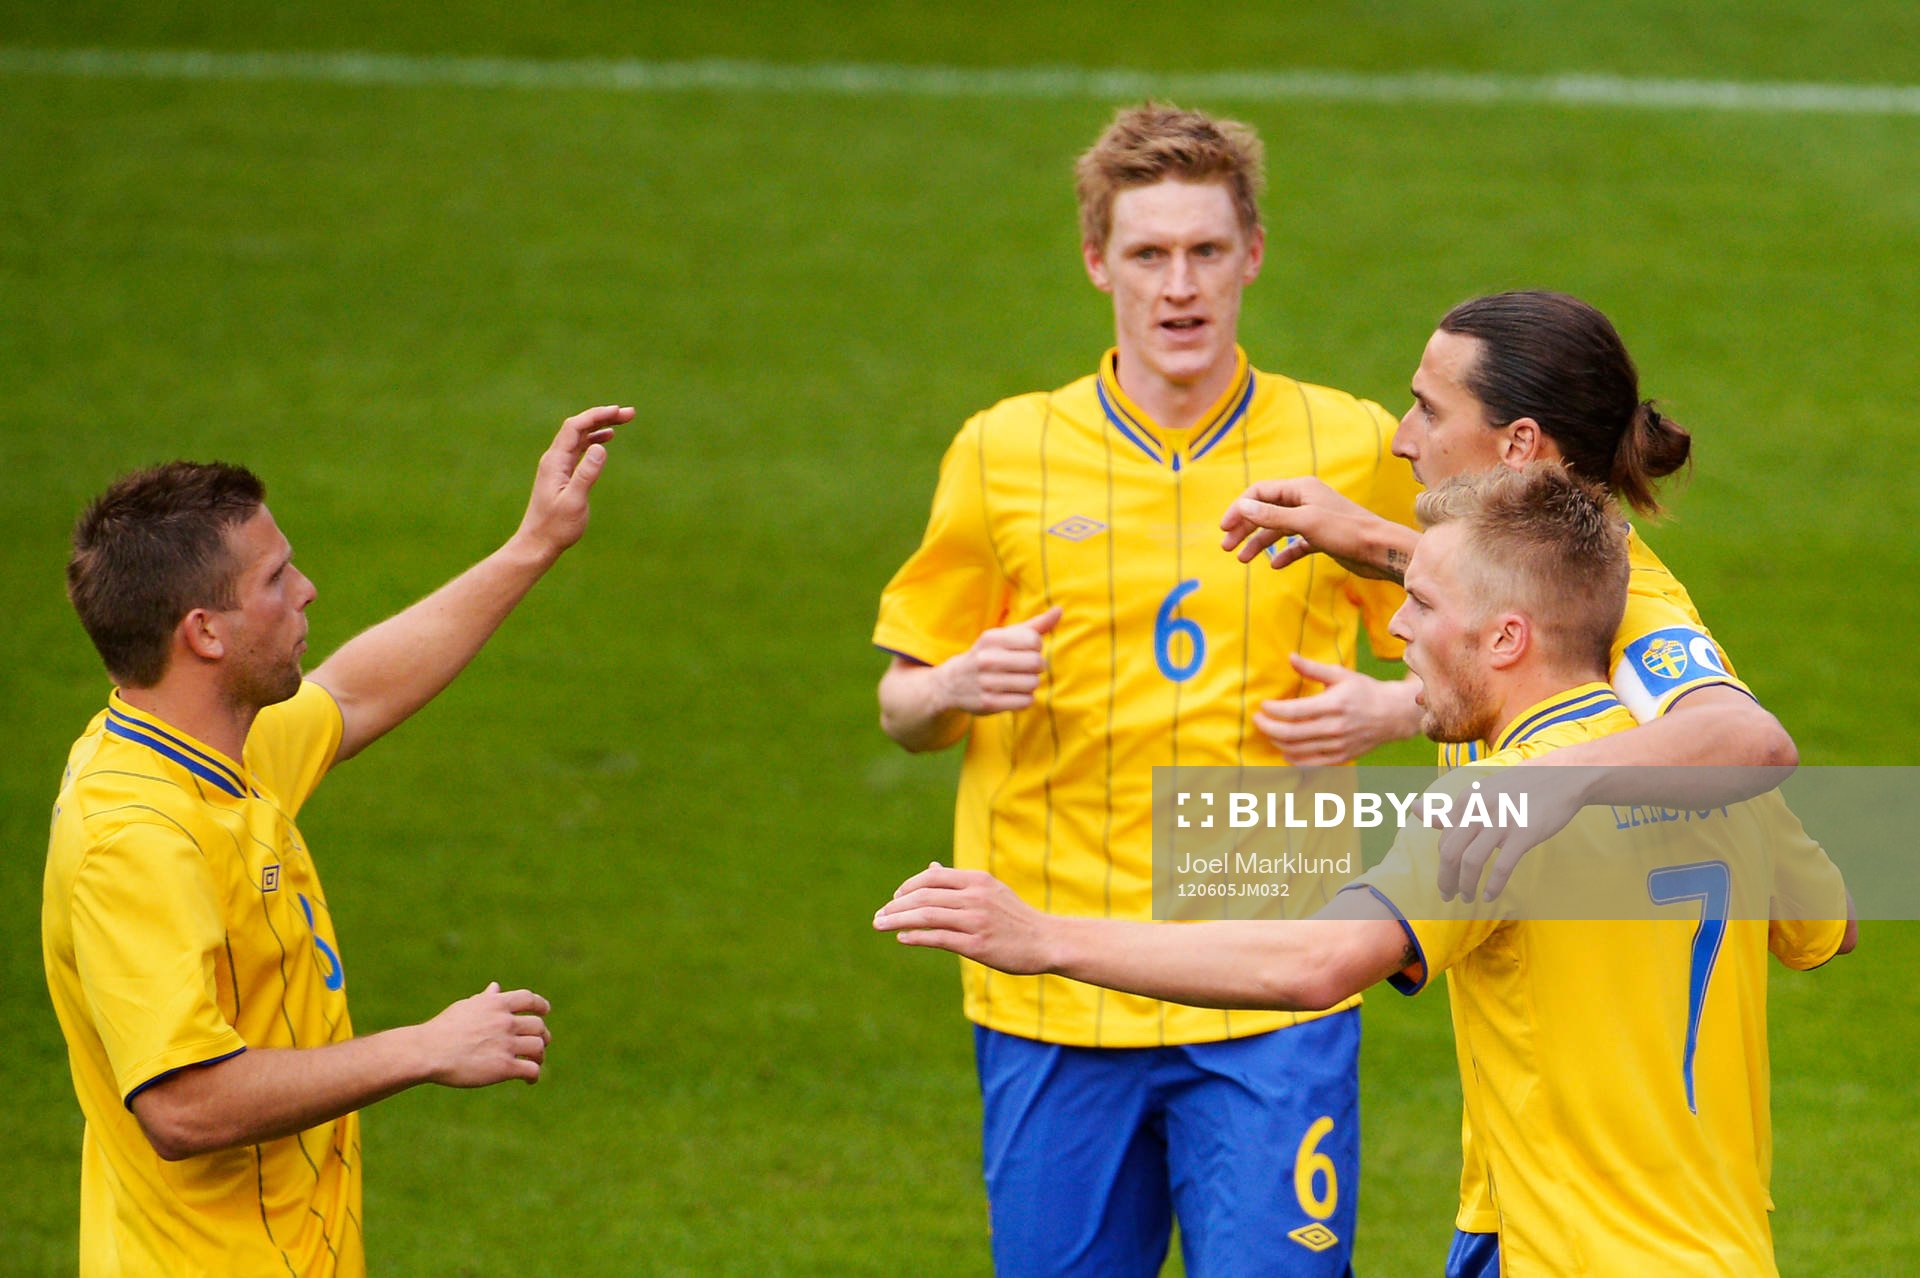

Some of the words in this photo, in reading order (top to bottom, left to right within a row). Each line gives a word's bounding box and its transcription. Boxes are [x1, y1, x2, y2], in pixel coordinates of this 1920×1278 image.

[1154, 579, 1206, 682] 6
[1647, 860, 1731, 1115] 7
[1294, 1115, 1338, 1221] 6
